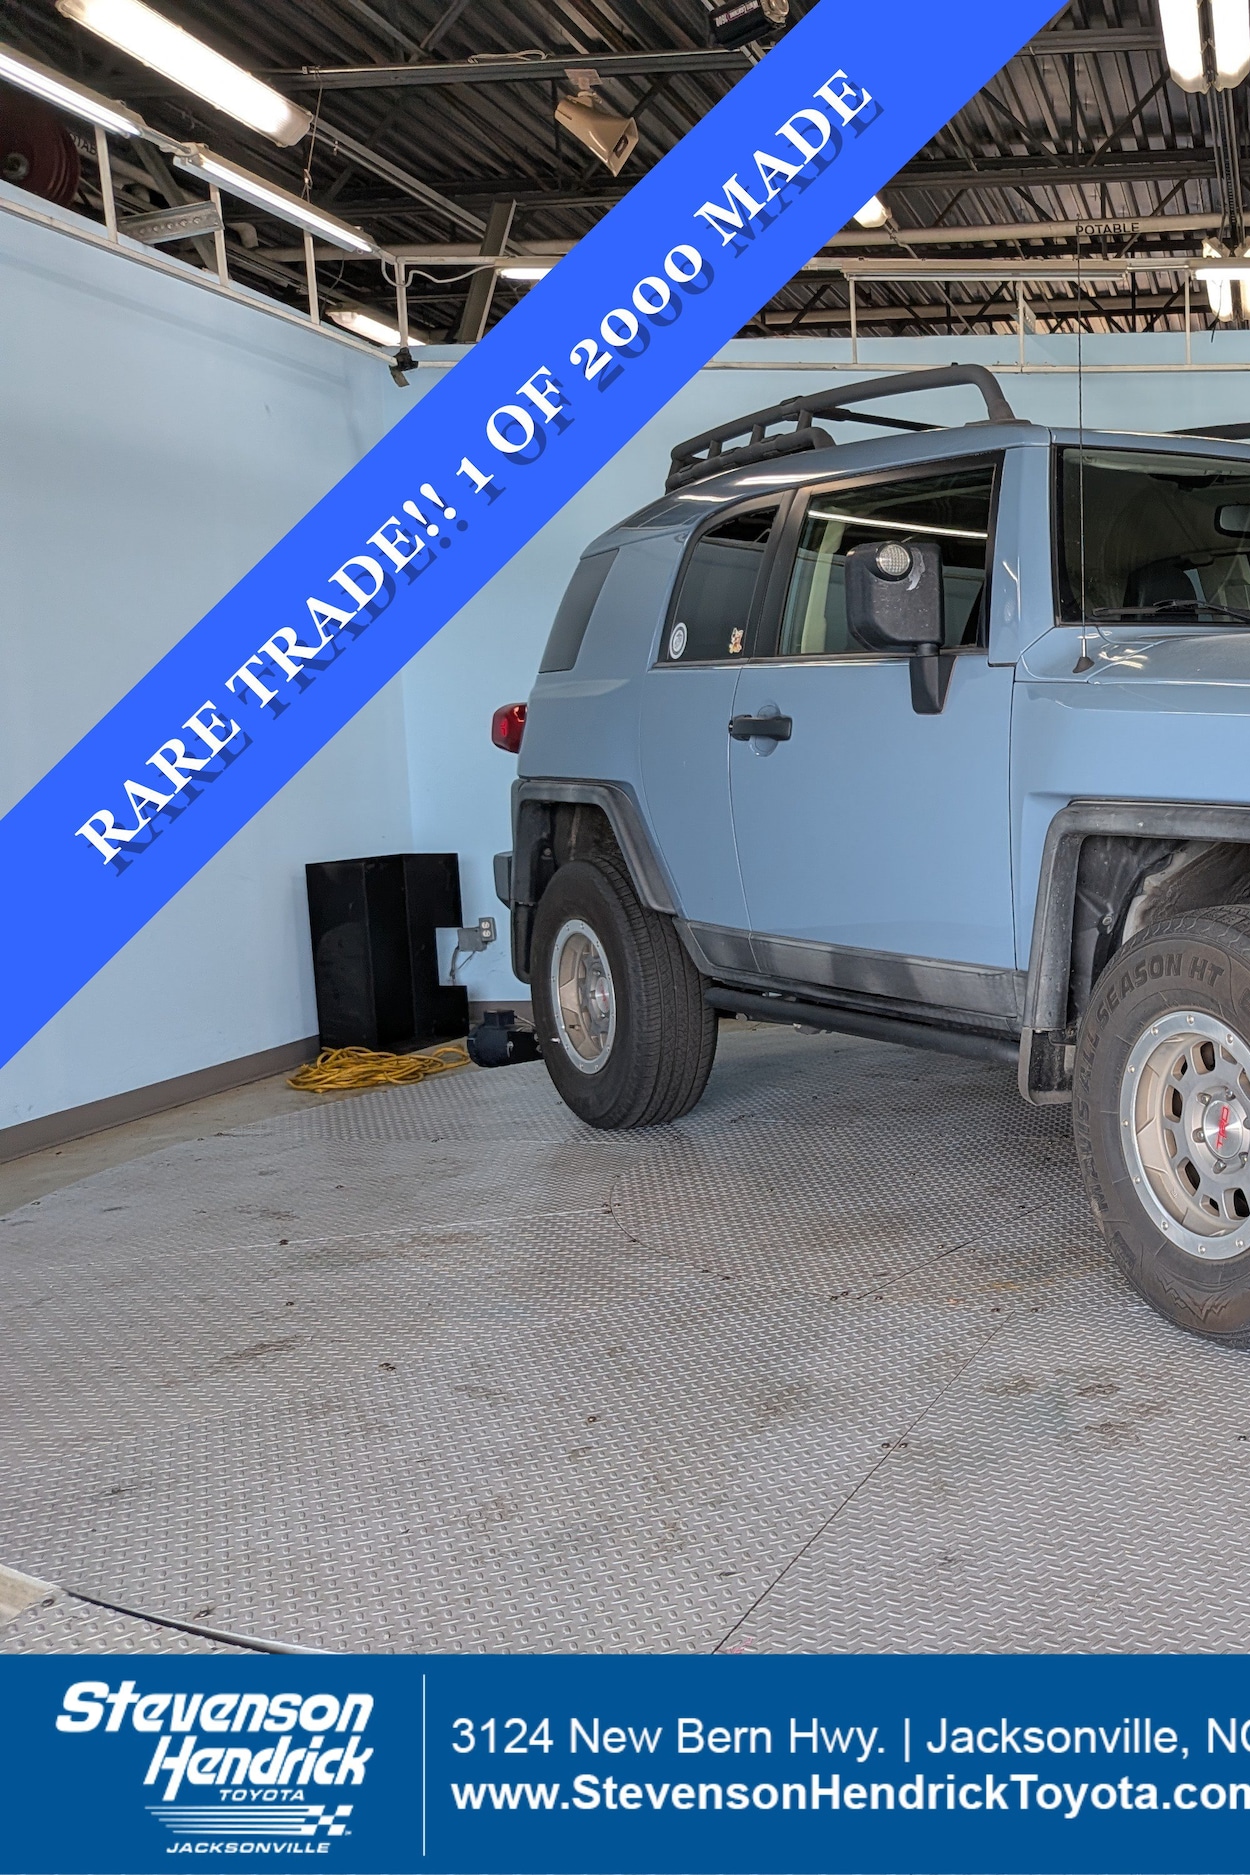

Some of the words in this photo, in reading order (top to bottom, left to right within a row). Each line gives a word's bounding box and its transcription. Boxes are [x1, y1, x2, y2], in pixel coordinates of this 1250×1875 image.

[1075, 222, 1140, 235] POTABLE
[1079, 1030, 1101, 1093] ALL
[1096, 953, 1184, 1029] SEASON
[1187, 956, 1225, 987] HT
[1215, 1104, 1230, 1150] TRD
